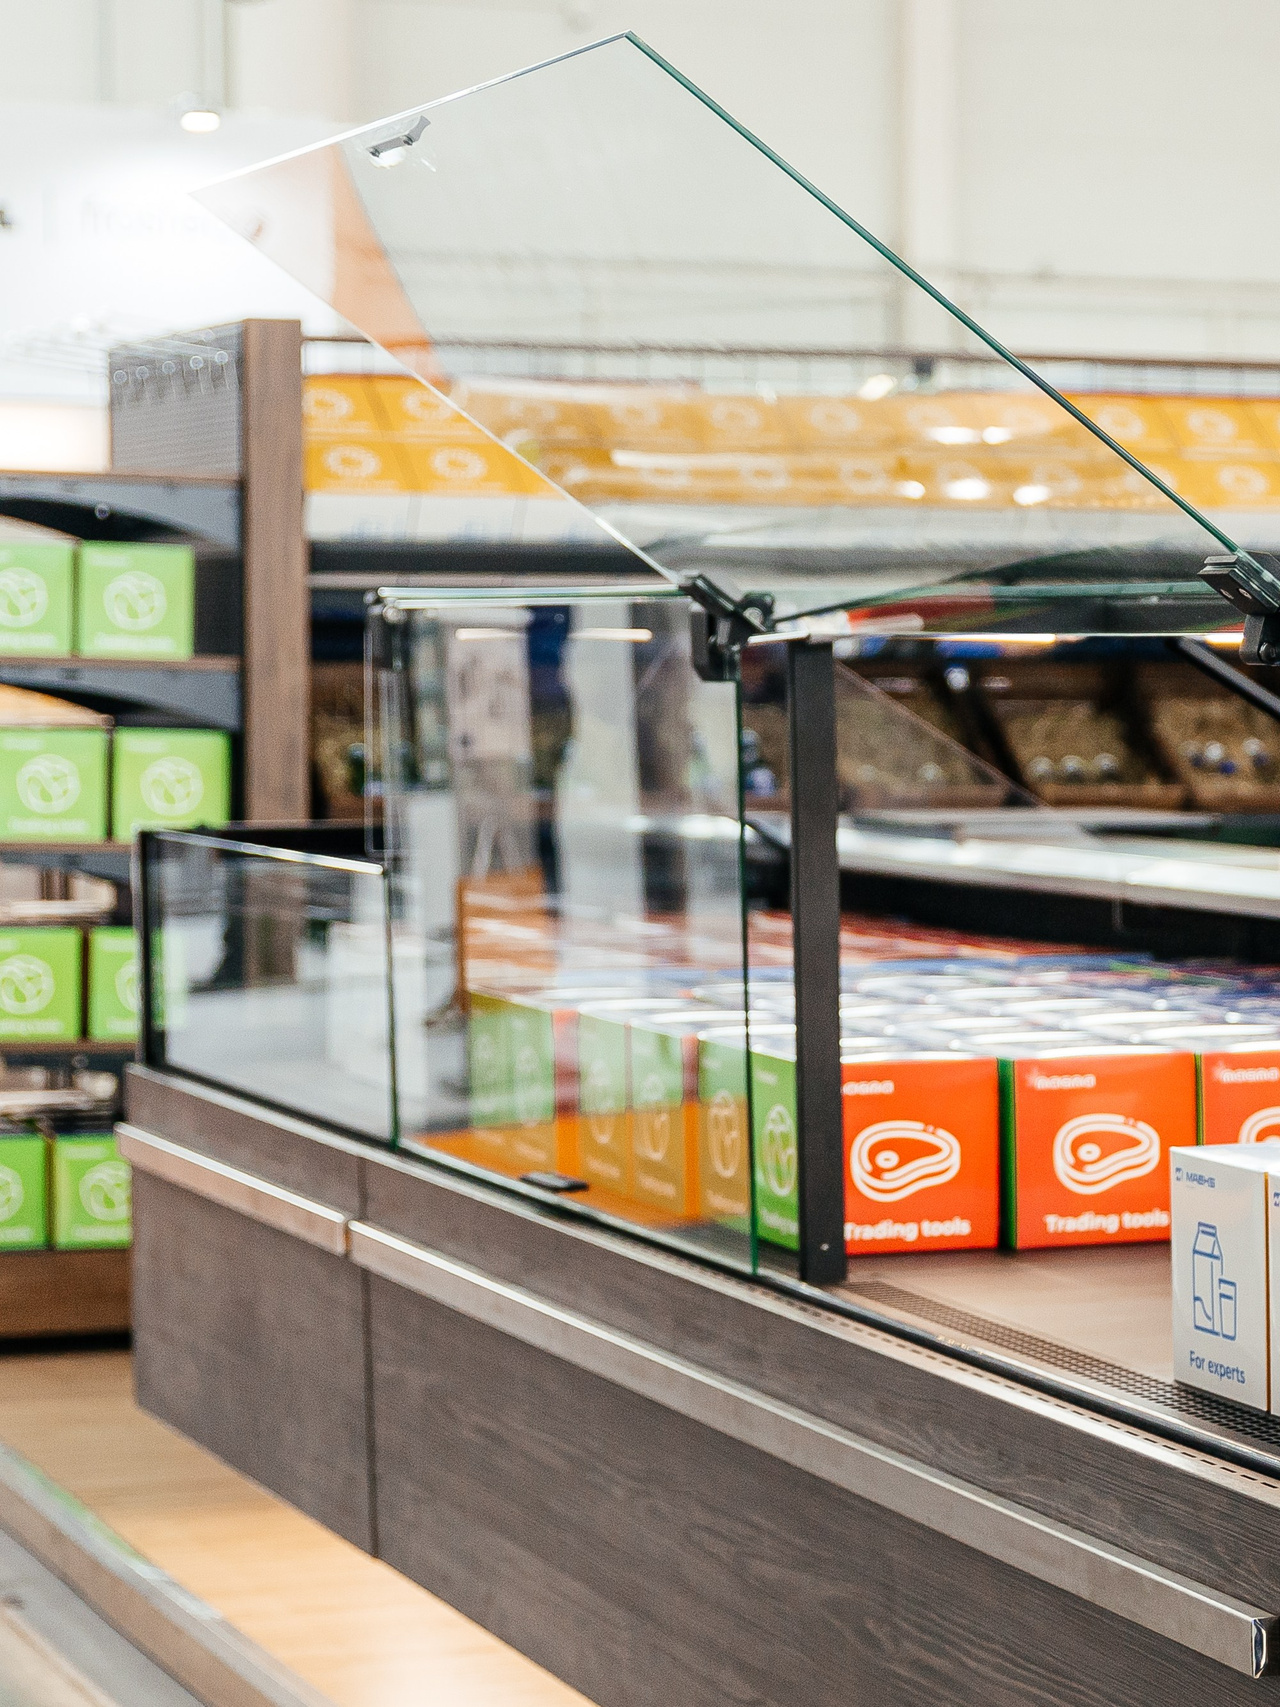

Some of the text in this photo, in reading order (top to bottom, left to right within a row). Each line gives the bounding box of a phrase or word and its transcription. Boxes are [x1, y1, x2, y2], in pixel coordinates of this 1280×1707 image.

[844, 1215, 971, 1242] Trading tools
[1044, 1207, 1170, 1233] Trading tools
[1189, 1350, 1246, 1384] For experts
